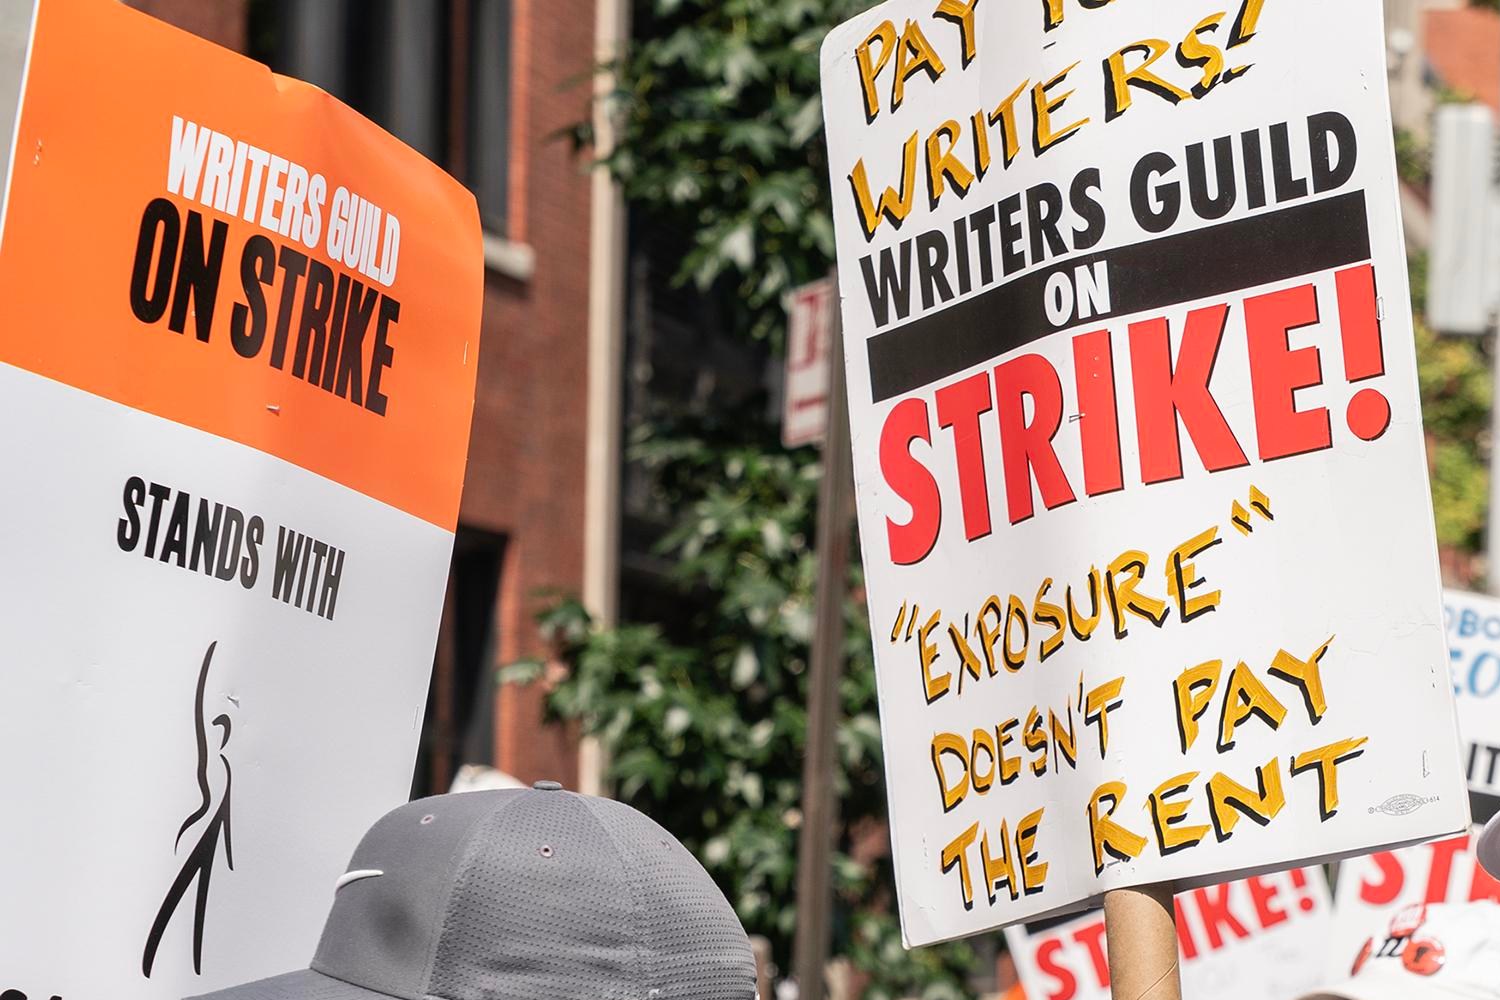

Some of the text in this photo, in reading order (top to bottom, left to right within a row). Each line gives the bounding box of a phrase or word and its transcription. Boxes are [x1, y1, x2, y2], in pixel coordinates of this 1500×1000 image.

[854, 0, 978, 126] PAY
[167, 115, 401, 288] WRITERS GUILD
[859, 111, 1358, 329] WRITERS GUILD
[129, 198, 401, 417] ON STRIKE
[1043, 260, 1112, 328] ON
[878, 263, 1391, 567] STRIKE!
[117, 476, 345, 622] STANDS WITH
[931, 633, 1337, 814] DOESN'T PAY
[940, 806, 1050, 911] THE
[1085, 736, 1369, 878] RENT
